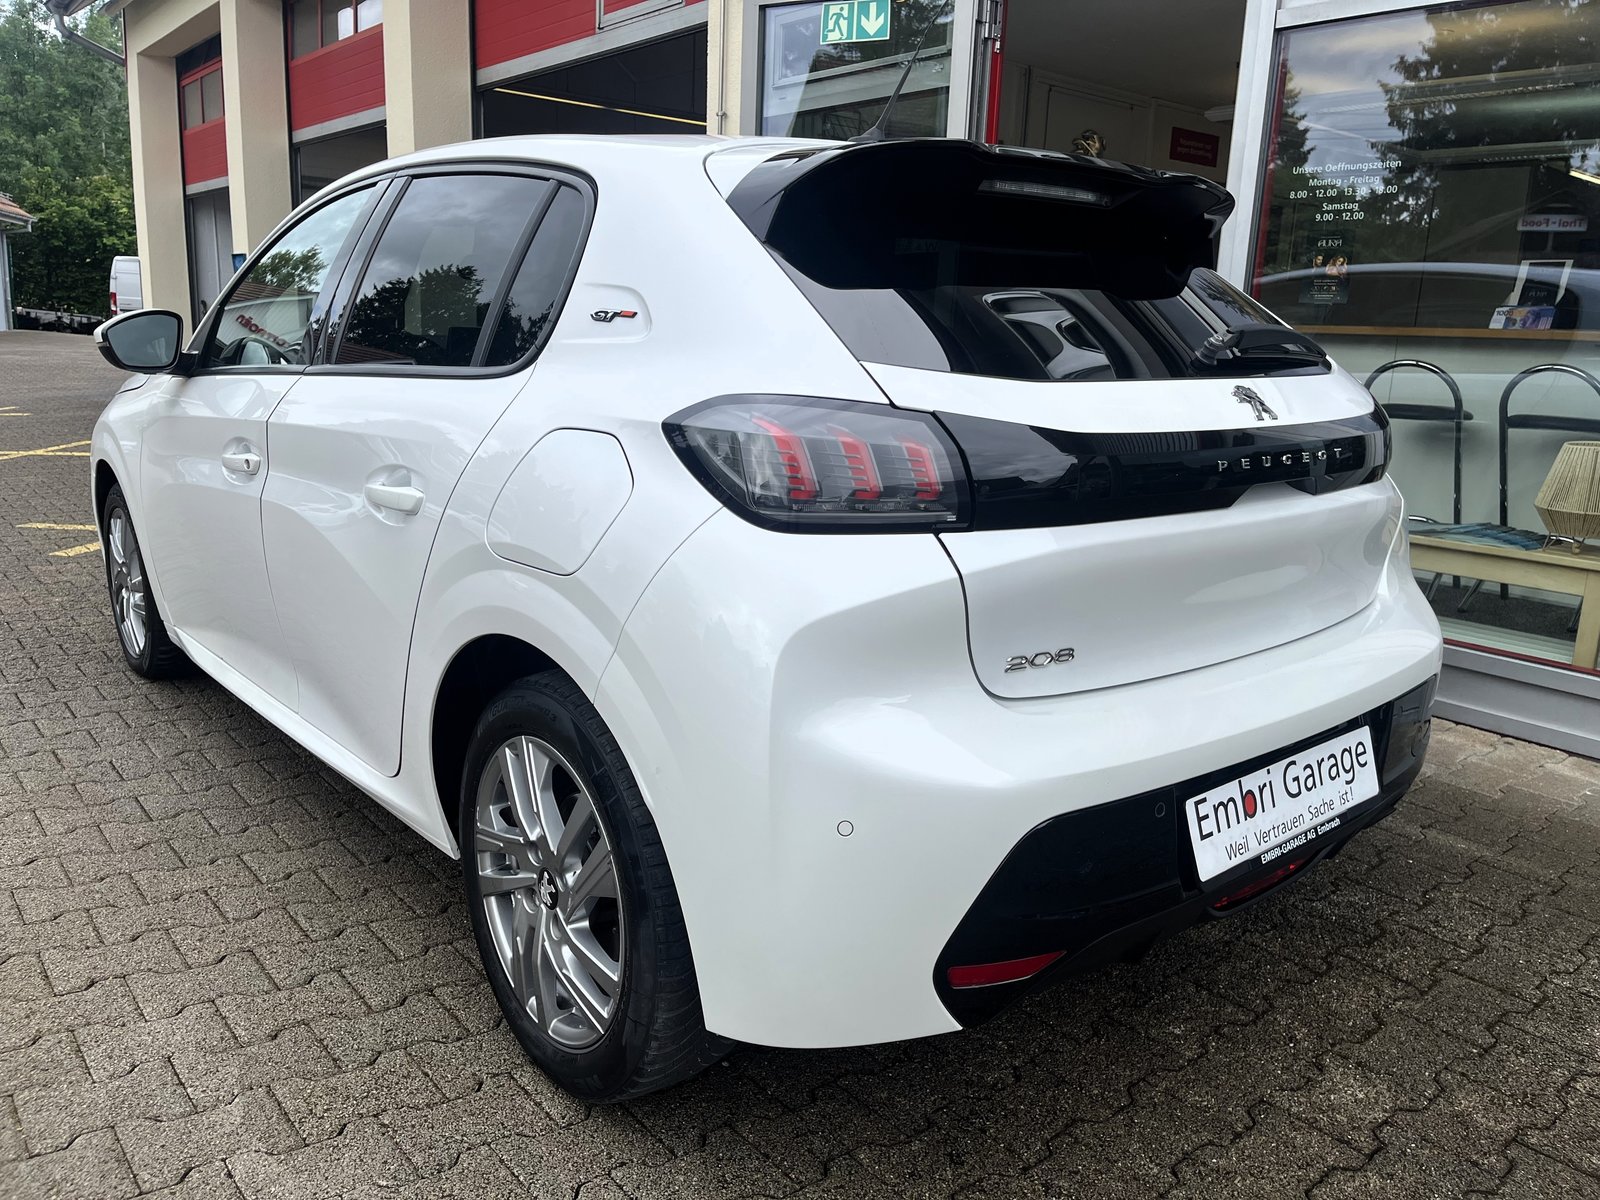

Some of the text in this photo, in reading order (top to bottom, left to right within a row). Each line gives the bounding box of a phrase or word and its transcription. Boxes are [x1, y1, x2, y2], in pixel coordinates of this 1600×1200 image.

[1293, 160, 1402, 175] Unsere Oeffnungszeiten
[1308, 177, 1342, 187] Montag
[1350, 175, 1380, 185] Freitag
[1289, 190, 1307, 199] 8.00
[1316, 188, 1337, 198] 12.00
[1344, 187, 1366, 196] 13.30
[1375, 185, 1398, 195] 18.00
[1315, 213, 1334, 222] 9.00
[1342, 211, 1365, 221] 12.00
[1322, 202, 1359, 211] Samstag
[1217, 447, 1342, 472] PEUGEOT
[1004, 647, 1075, 673] 208
[1194, 740, 1368, 841] Embri Garage
[1224, 835, 1250, 861] Weil
[1253, 813, 1305, 847] Vertrauen
[1307, 798, 1335, 821] Sache
[1260, 817, 1341, 865] EMBRI-GARAGE AG Embrach
